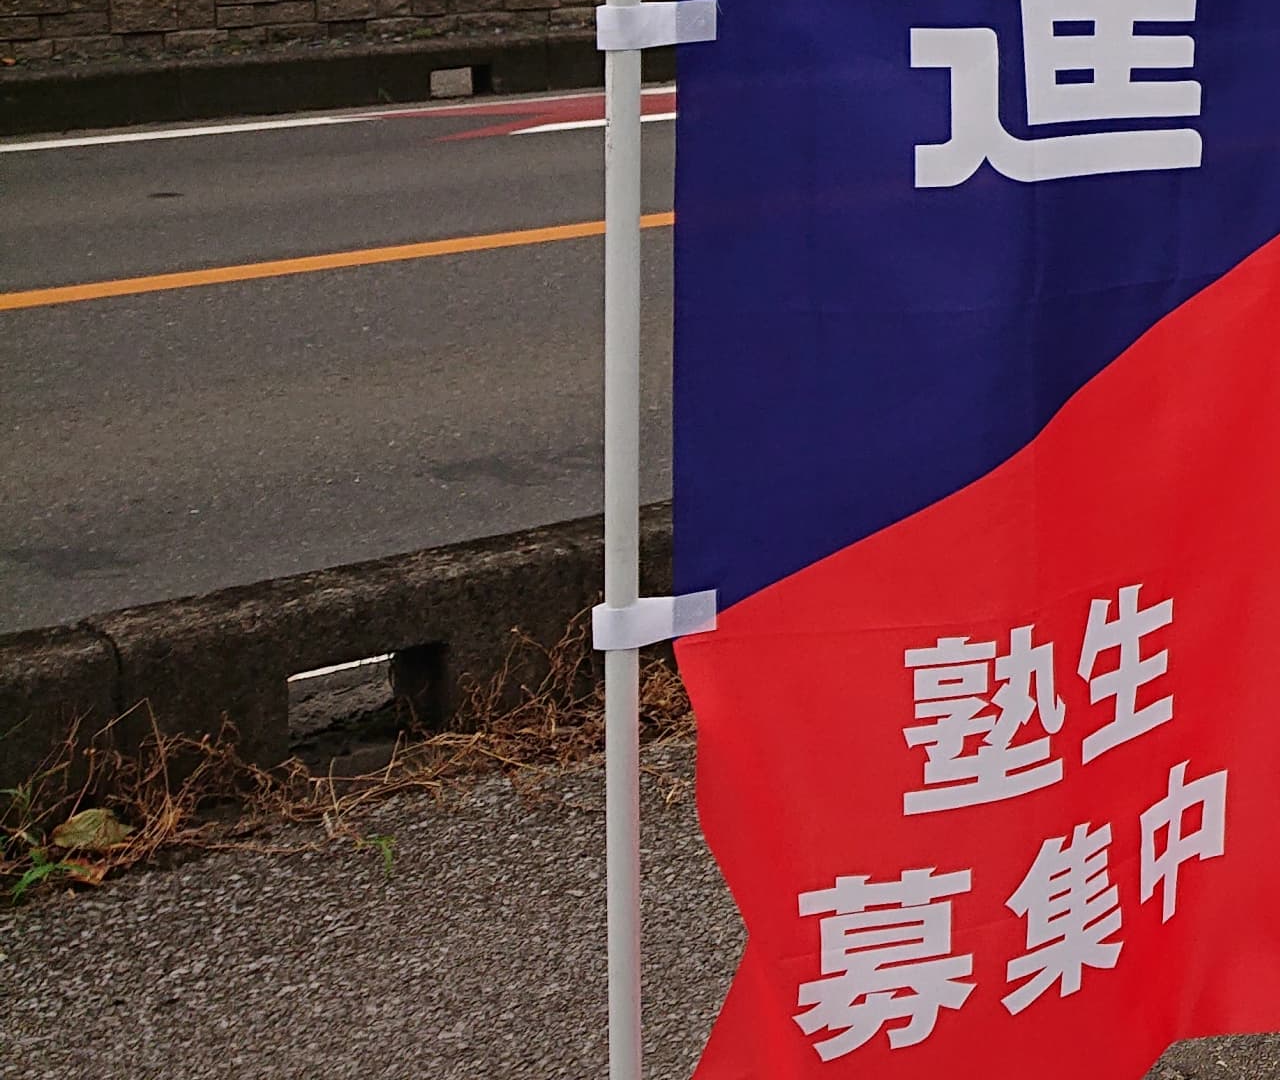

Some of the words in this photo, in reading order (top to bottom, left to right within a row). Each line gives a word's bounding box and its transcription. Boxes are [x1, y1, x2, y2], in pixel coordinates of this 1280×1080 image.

[902, 583, 1175, 817] 塾生
[792, 760, 1229, 1062] 募集中
